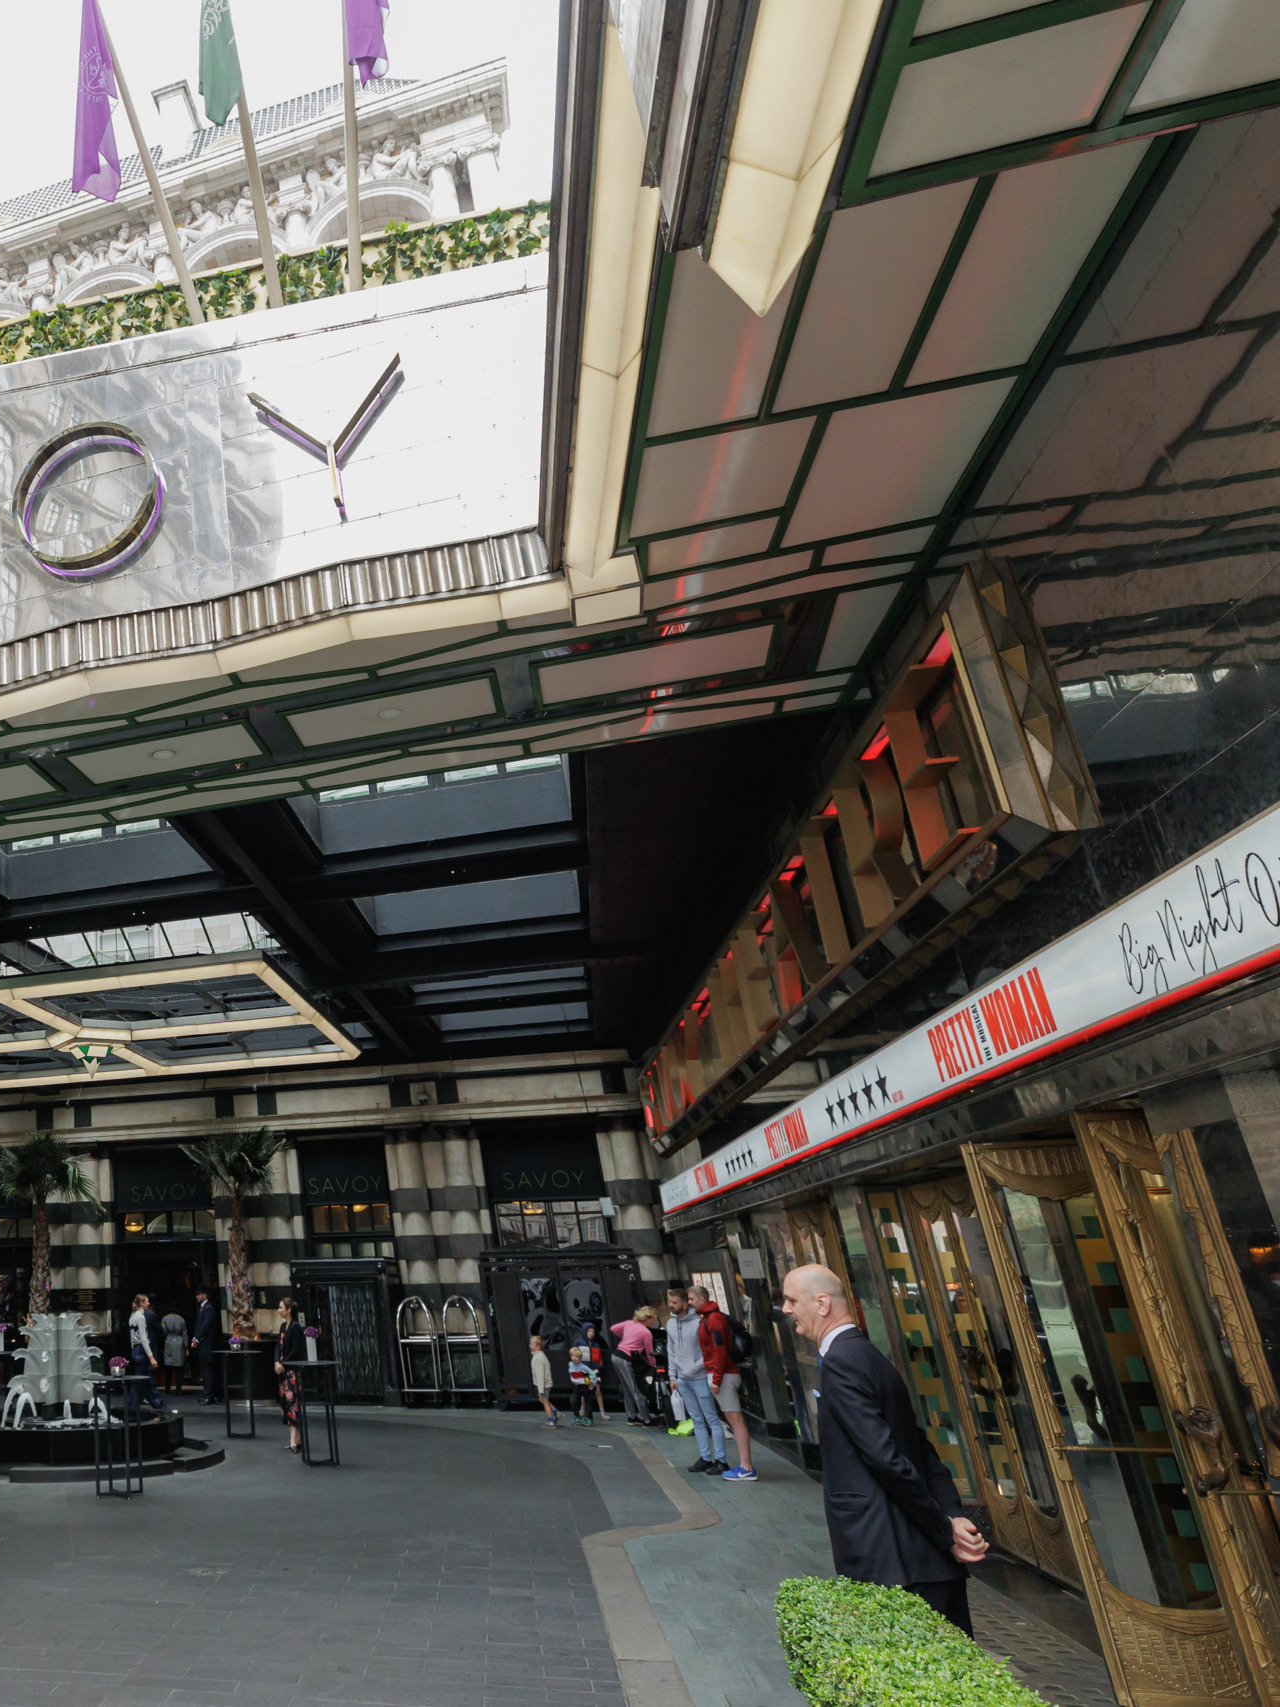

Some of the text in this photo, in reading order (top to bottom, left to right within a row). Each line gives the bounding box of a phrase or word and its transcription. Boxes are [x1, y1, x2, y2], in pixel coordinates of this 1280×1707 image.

[1119, 923, 1170, 996] Big
[1156, 858, 1244, 976] Night
[927, 966, 1058, 1083] PRETTY WOMAN
[970, 1003, 987, 1043] MUSICAL
[131, 1183, 198, 1201] SAVOY
[308, 1175, 382, 1195] SAVOY
[502, 1169, 584, 1190] SAVOY
